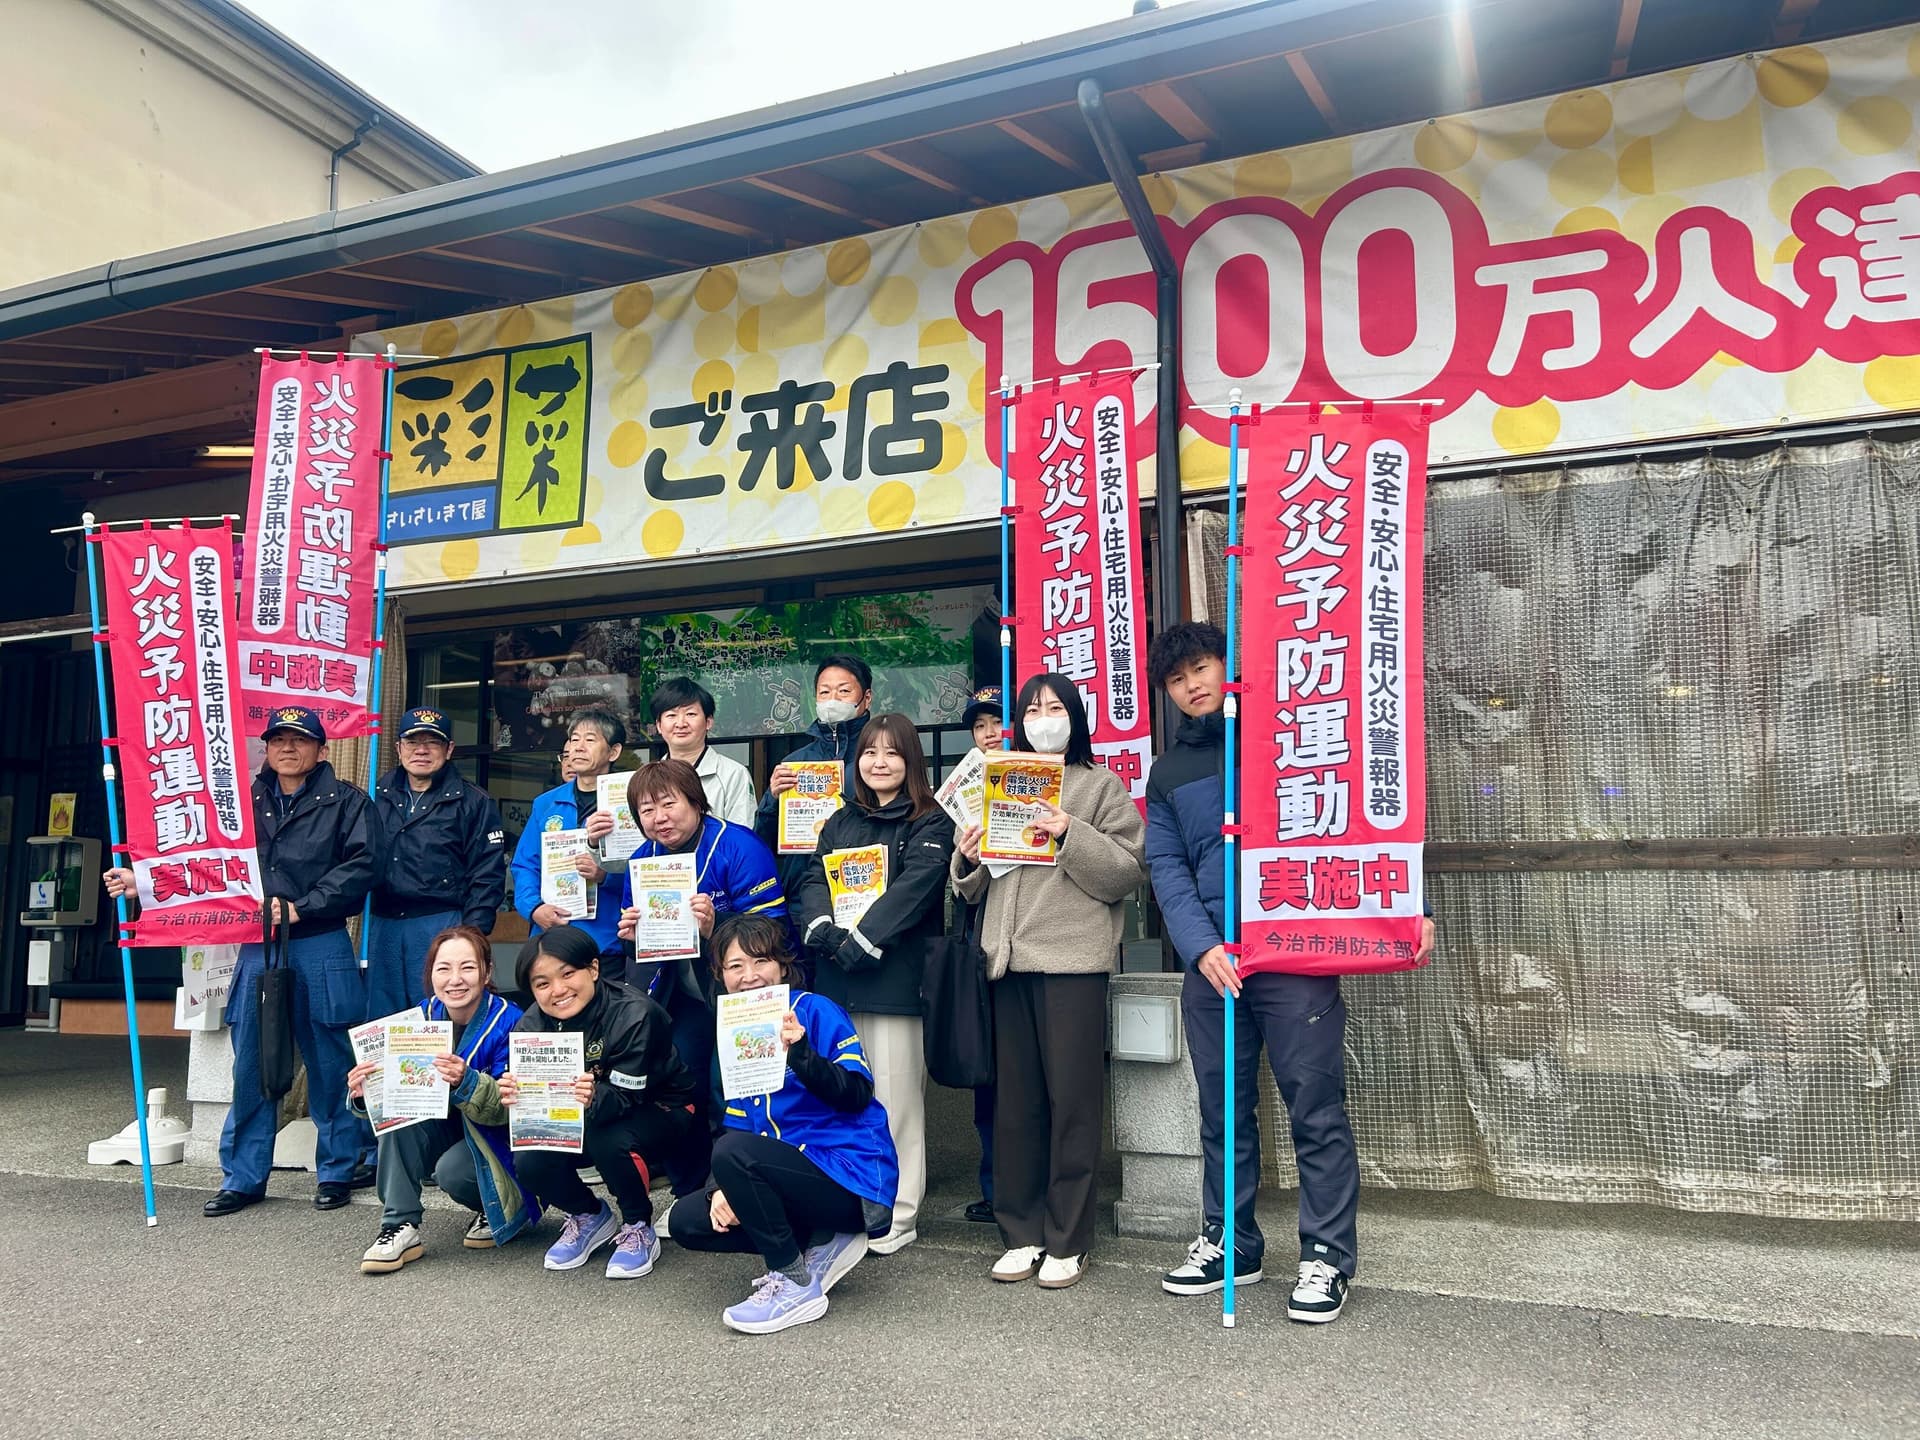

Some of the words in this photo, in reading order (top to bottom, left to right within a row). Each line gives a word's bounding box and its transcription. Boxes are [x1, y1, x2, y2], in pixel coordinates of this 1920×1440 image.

[644, 361, 950, 502] ご来店
[387, 499, 487, 530] さいさいきて屋
[1039, 402, 1098, 736] 火災予防運
[1098, 406, 1135, 721] 安全・安心・住宅用火災警報器
[129, 543, 208, 854] 火災予防運動
[194, 554, 239, 834] 安全・安心・住宅用火災警報器
[1276, 434, 1353, 843] 火災予防運動
[1368, 451, 1403, 816] 安全・安心・住宅用火災警報器
[1007, 775, 1050, 787] 電気火災
[151, 855, 252, 903] 実施中
[155, 908, 264, 927] 今治市消防本部
[1259, 851, 1410, 912] 実施中
[1264, 931, 1414, 961] 今治市消防本部
